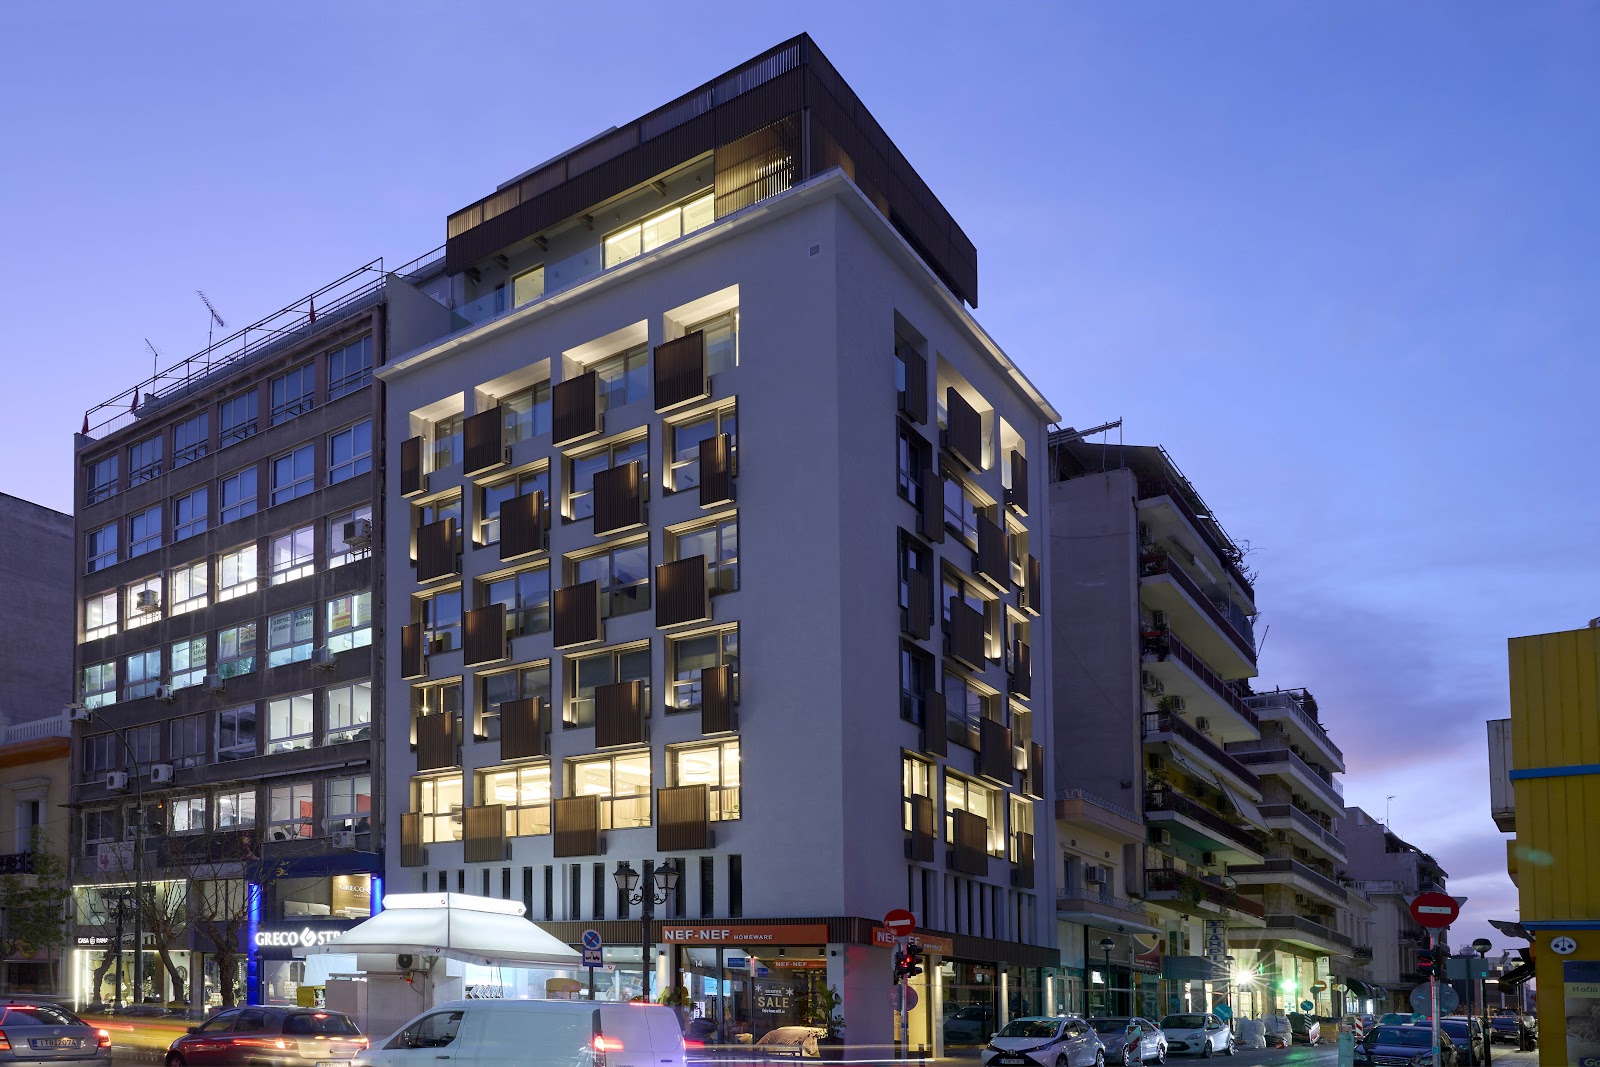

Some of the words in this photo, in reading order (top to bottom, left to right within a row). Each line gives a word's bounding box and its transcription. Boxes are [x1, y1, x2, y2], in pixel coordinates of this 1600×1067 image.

[254, 931, 299, 946] GRECO
[664, 929, 730, 940] NEF-NEF
[694, 960, 703, 968] 14
[757, 997, 790, 1008] SALE
